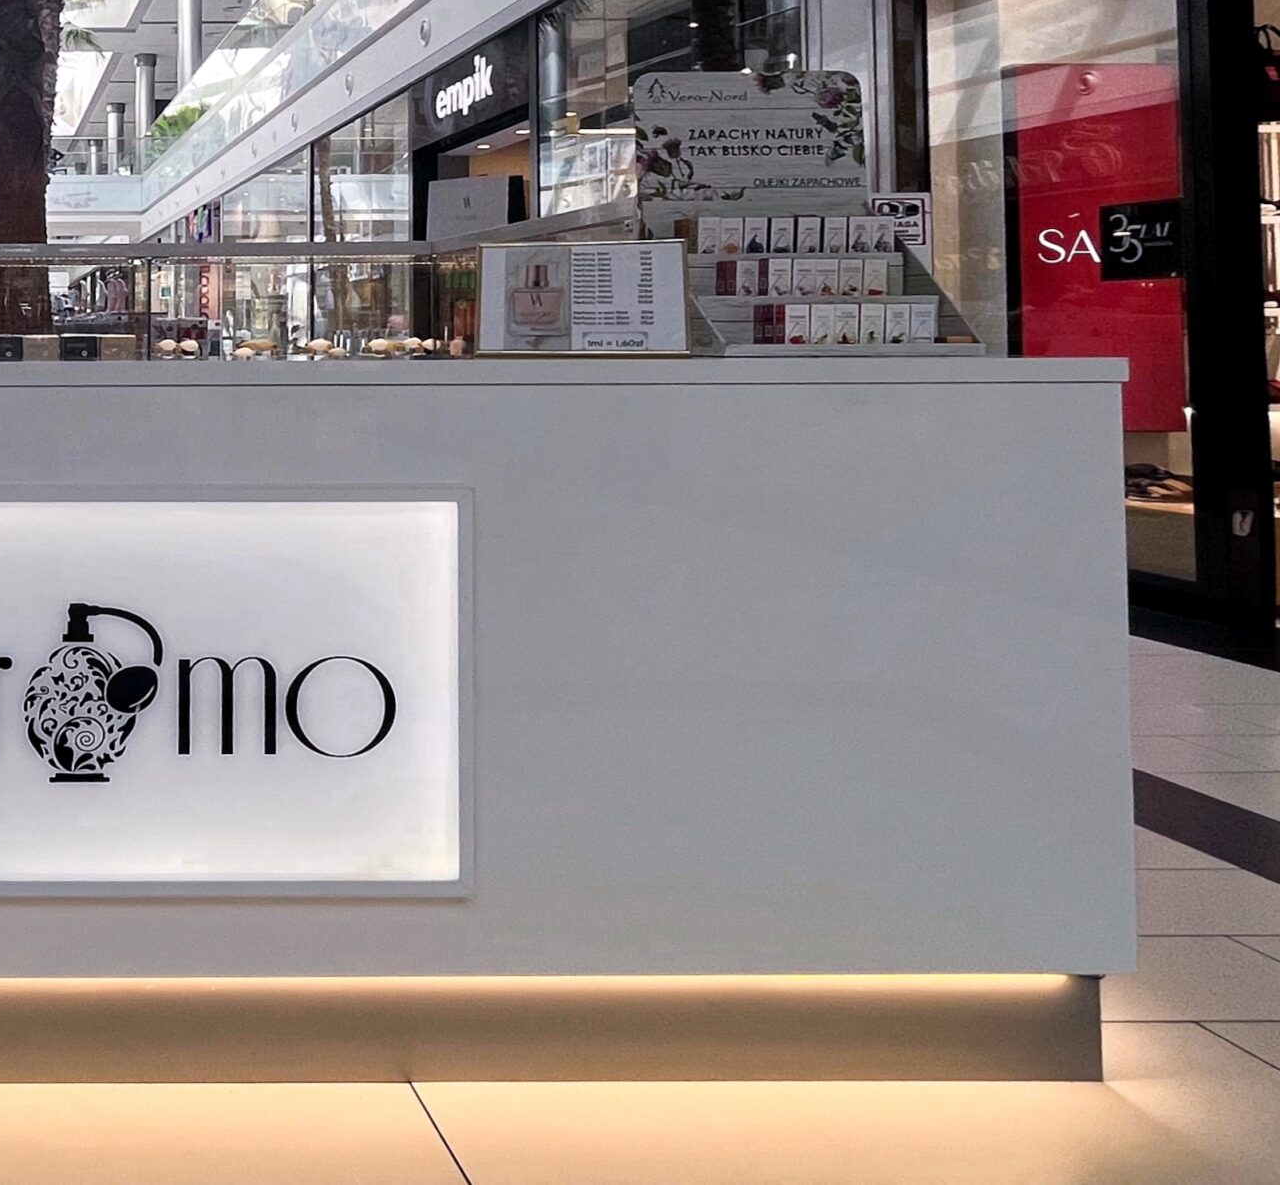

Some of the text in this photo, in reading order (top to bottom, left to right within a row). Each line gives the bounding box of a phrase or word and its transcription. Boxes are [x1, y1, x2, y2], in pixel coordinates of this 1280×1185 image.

[436, 54, 493, 119] empik
[669, 90, 747, 102] Vera-Nord
[688, 128, 824, 141] ZAPACHY NATURY
[688, 145, 824, 157] TAK BLISKO CIEBIE
[753, 177, 862, 188] OLEJKI ZAPACHOWE
